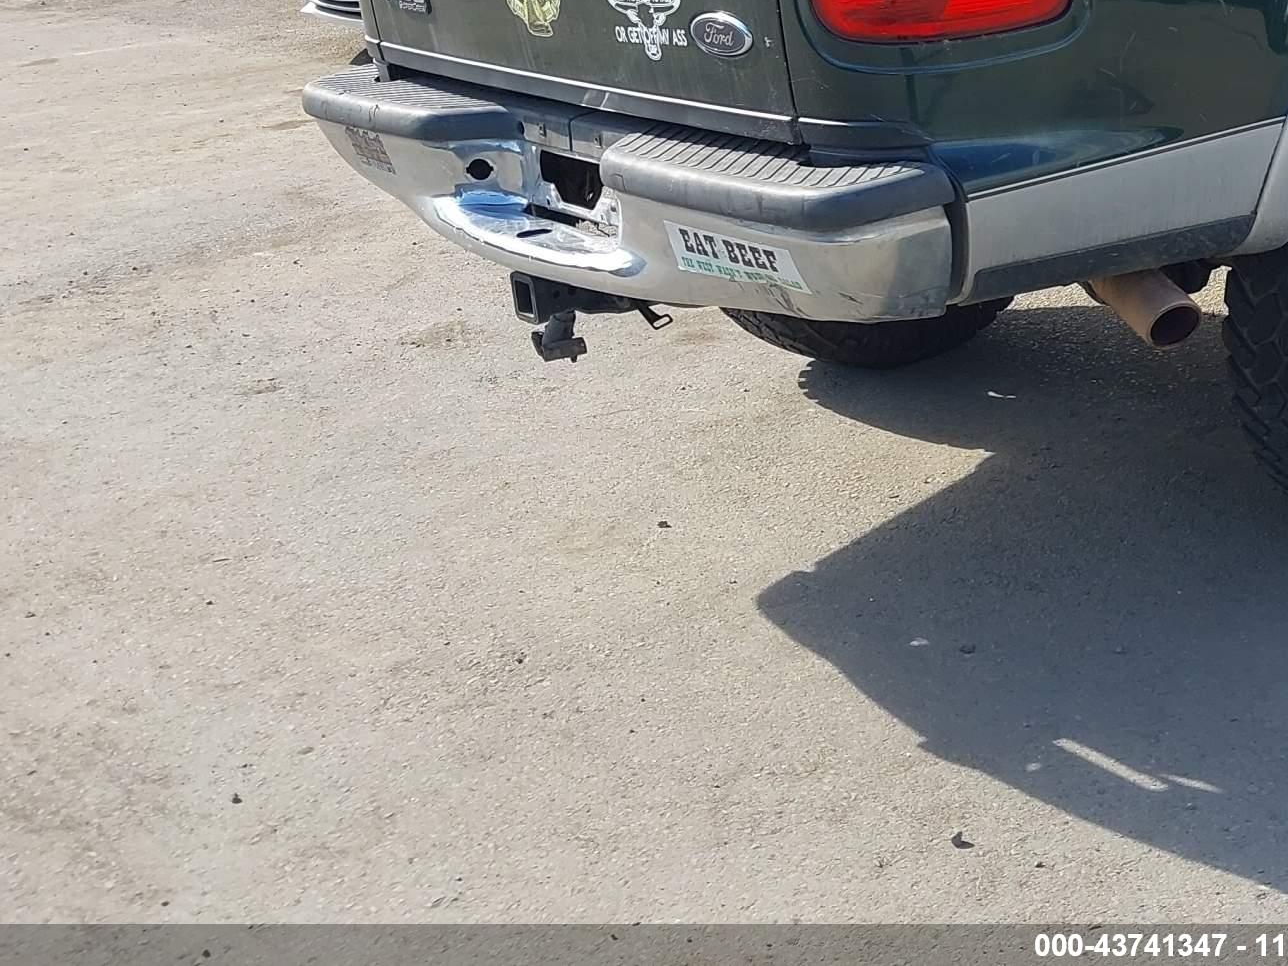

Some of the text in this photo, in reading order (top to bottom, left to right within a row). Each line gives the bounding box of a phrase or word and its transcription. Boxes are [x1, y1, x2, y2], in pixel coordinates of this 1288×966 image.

[615, 26, 628, 43] OR
[628, 26, 642, 44] GET
[672, 28, 688, 47] ASS
[703, 22, 735, 47] Ford
[678, 228, 780, 273] EAT BEEF
